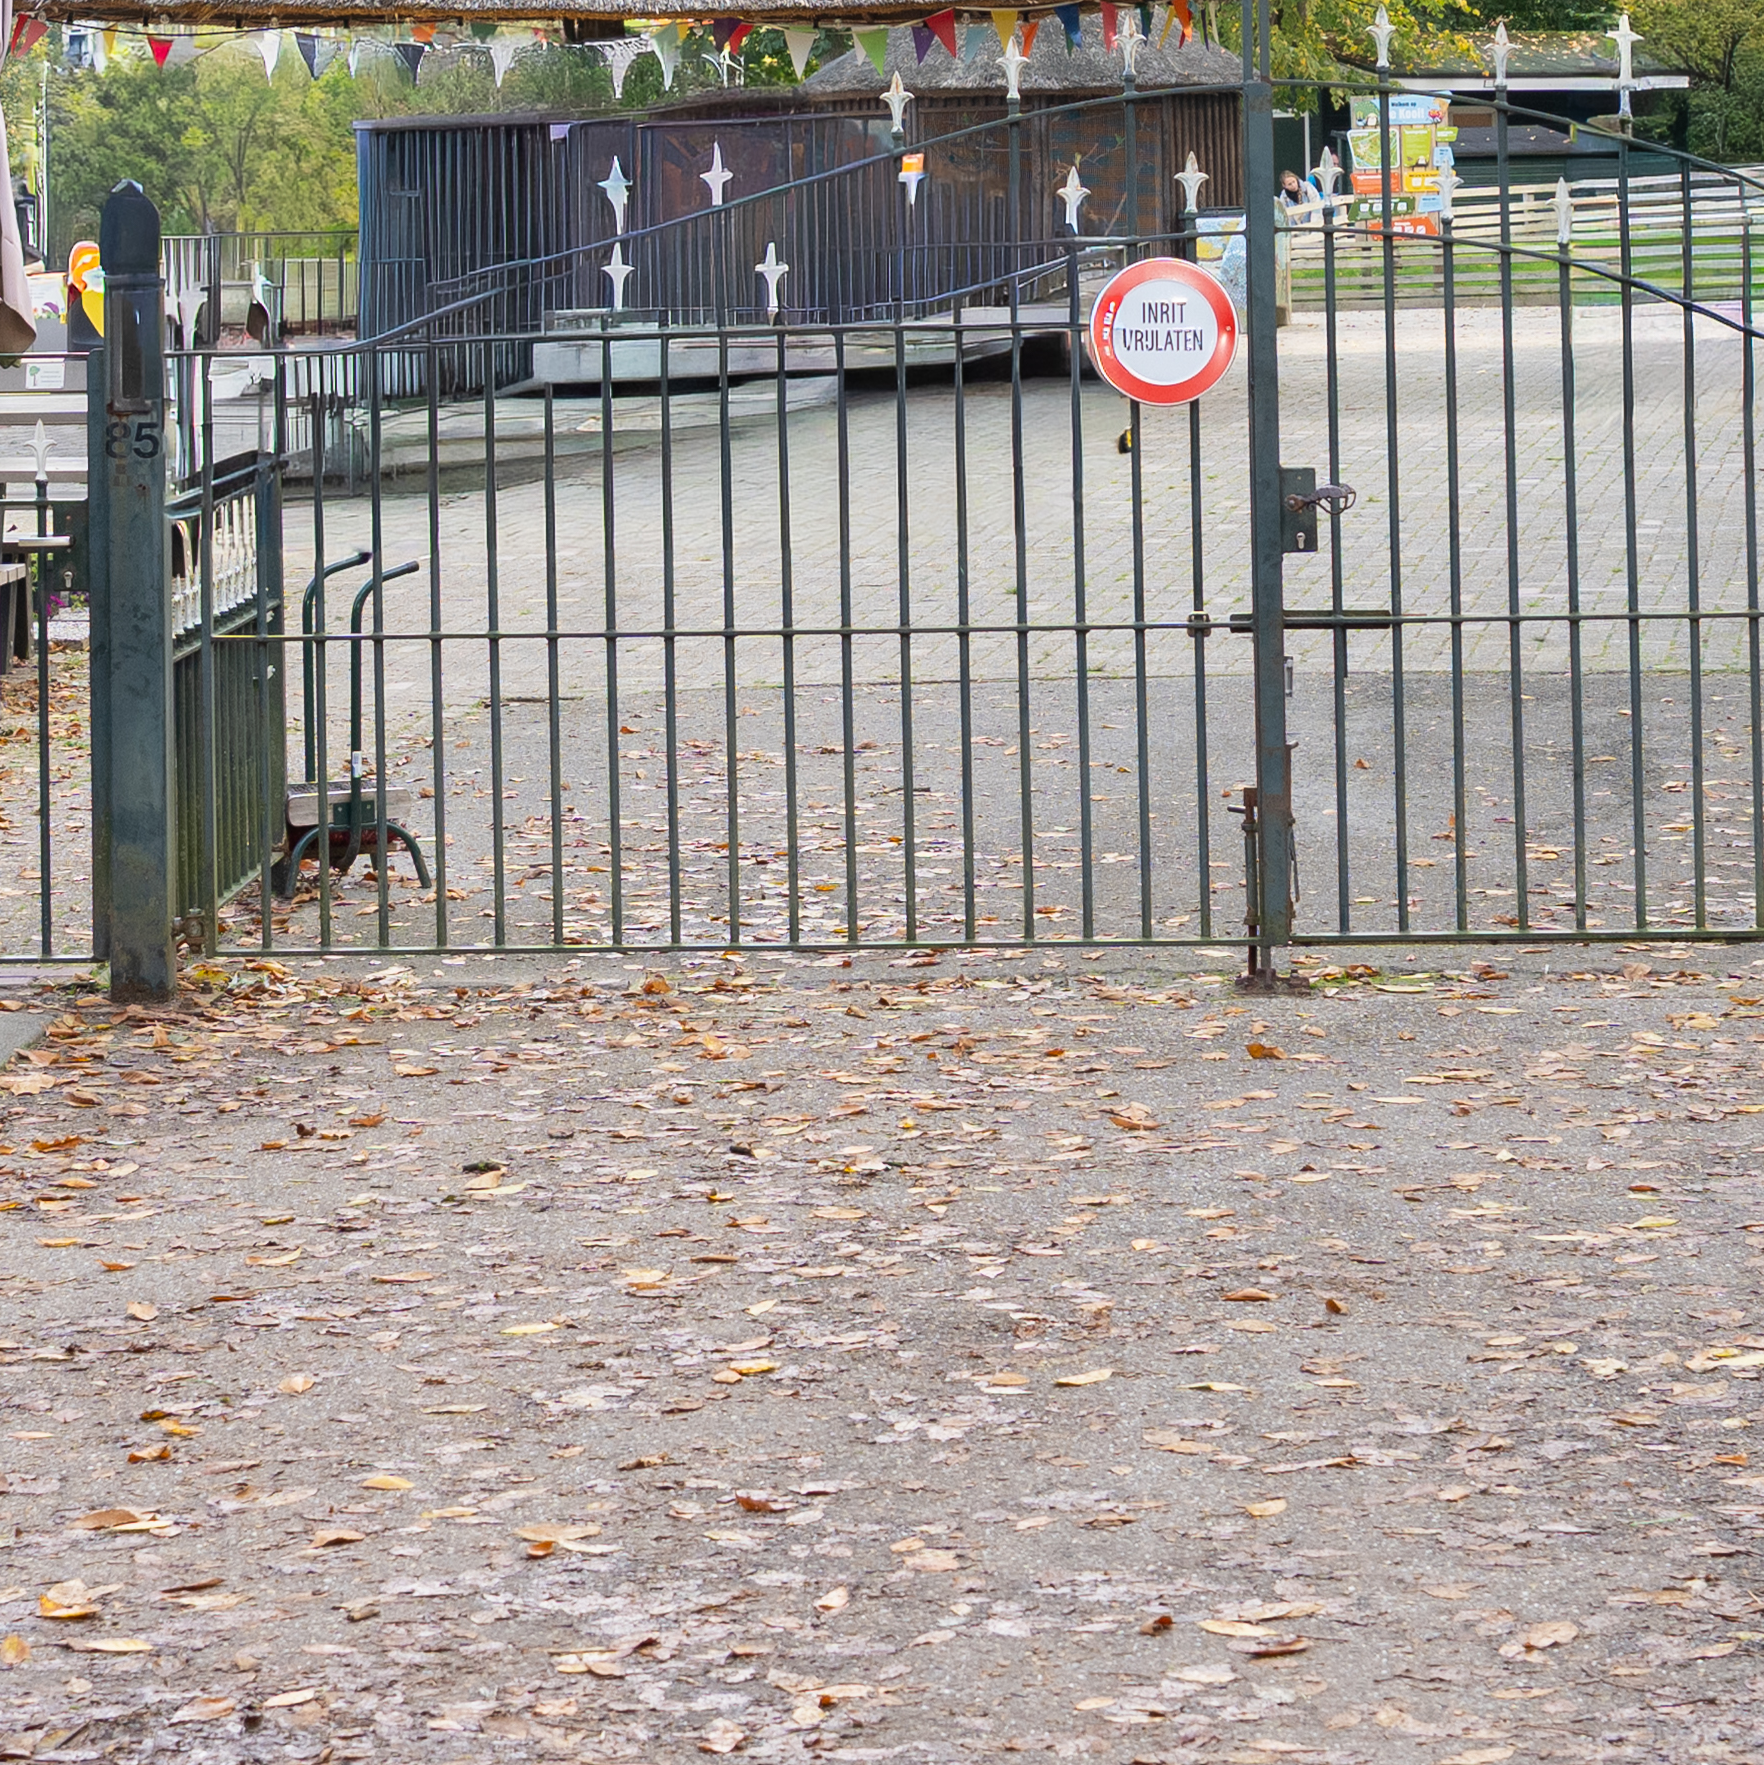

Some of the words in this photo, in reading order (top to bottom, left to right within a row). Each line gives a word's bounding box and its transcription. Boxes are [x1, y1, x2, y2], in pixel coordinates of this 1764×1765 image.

[1399, 108, 1425, 120] Kooi!
[1142, 302, 1187, 324] INRIT
[1122, 328, 1203, 351] VRIJLATEN
[105, 422, 160, 459] 85
